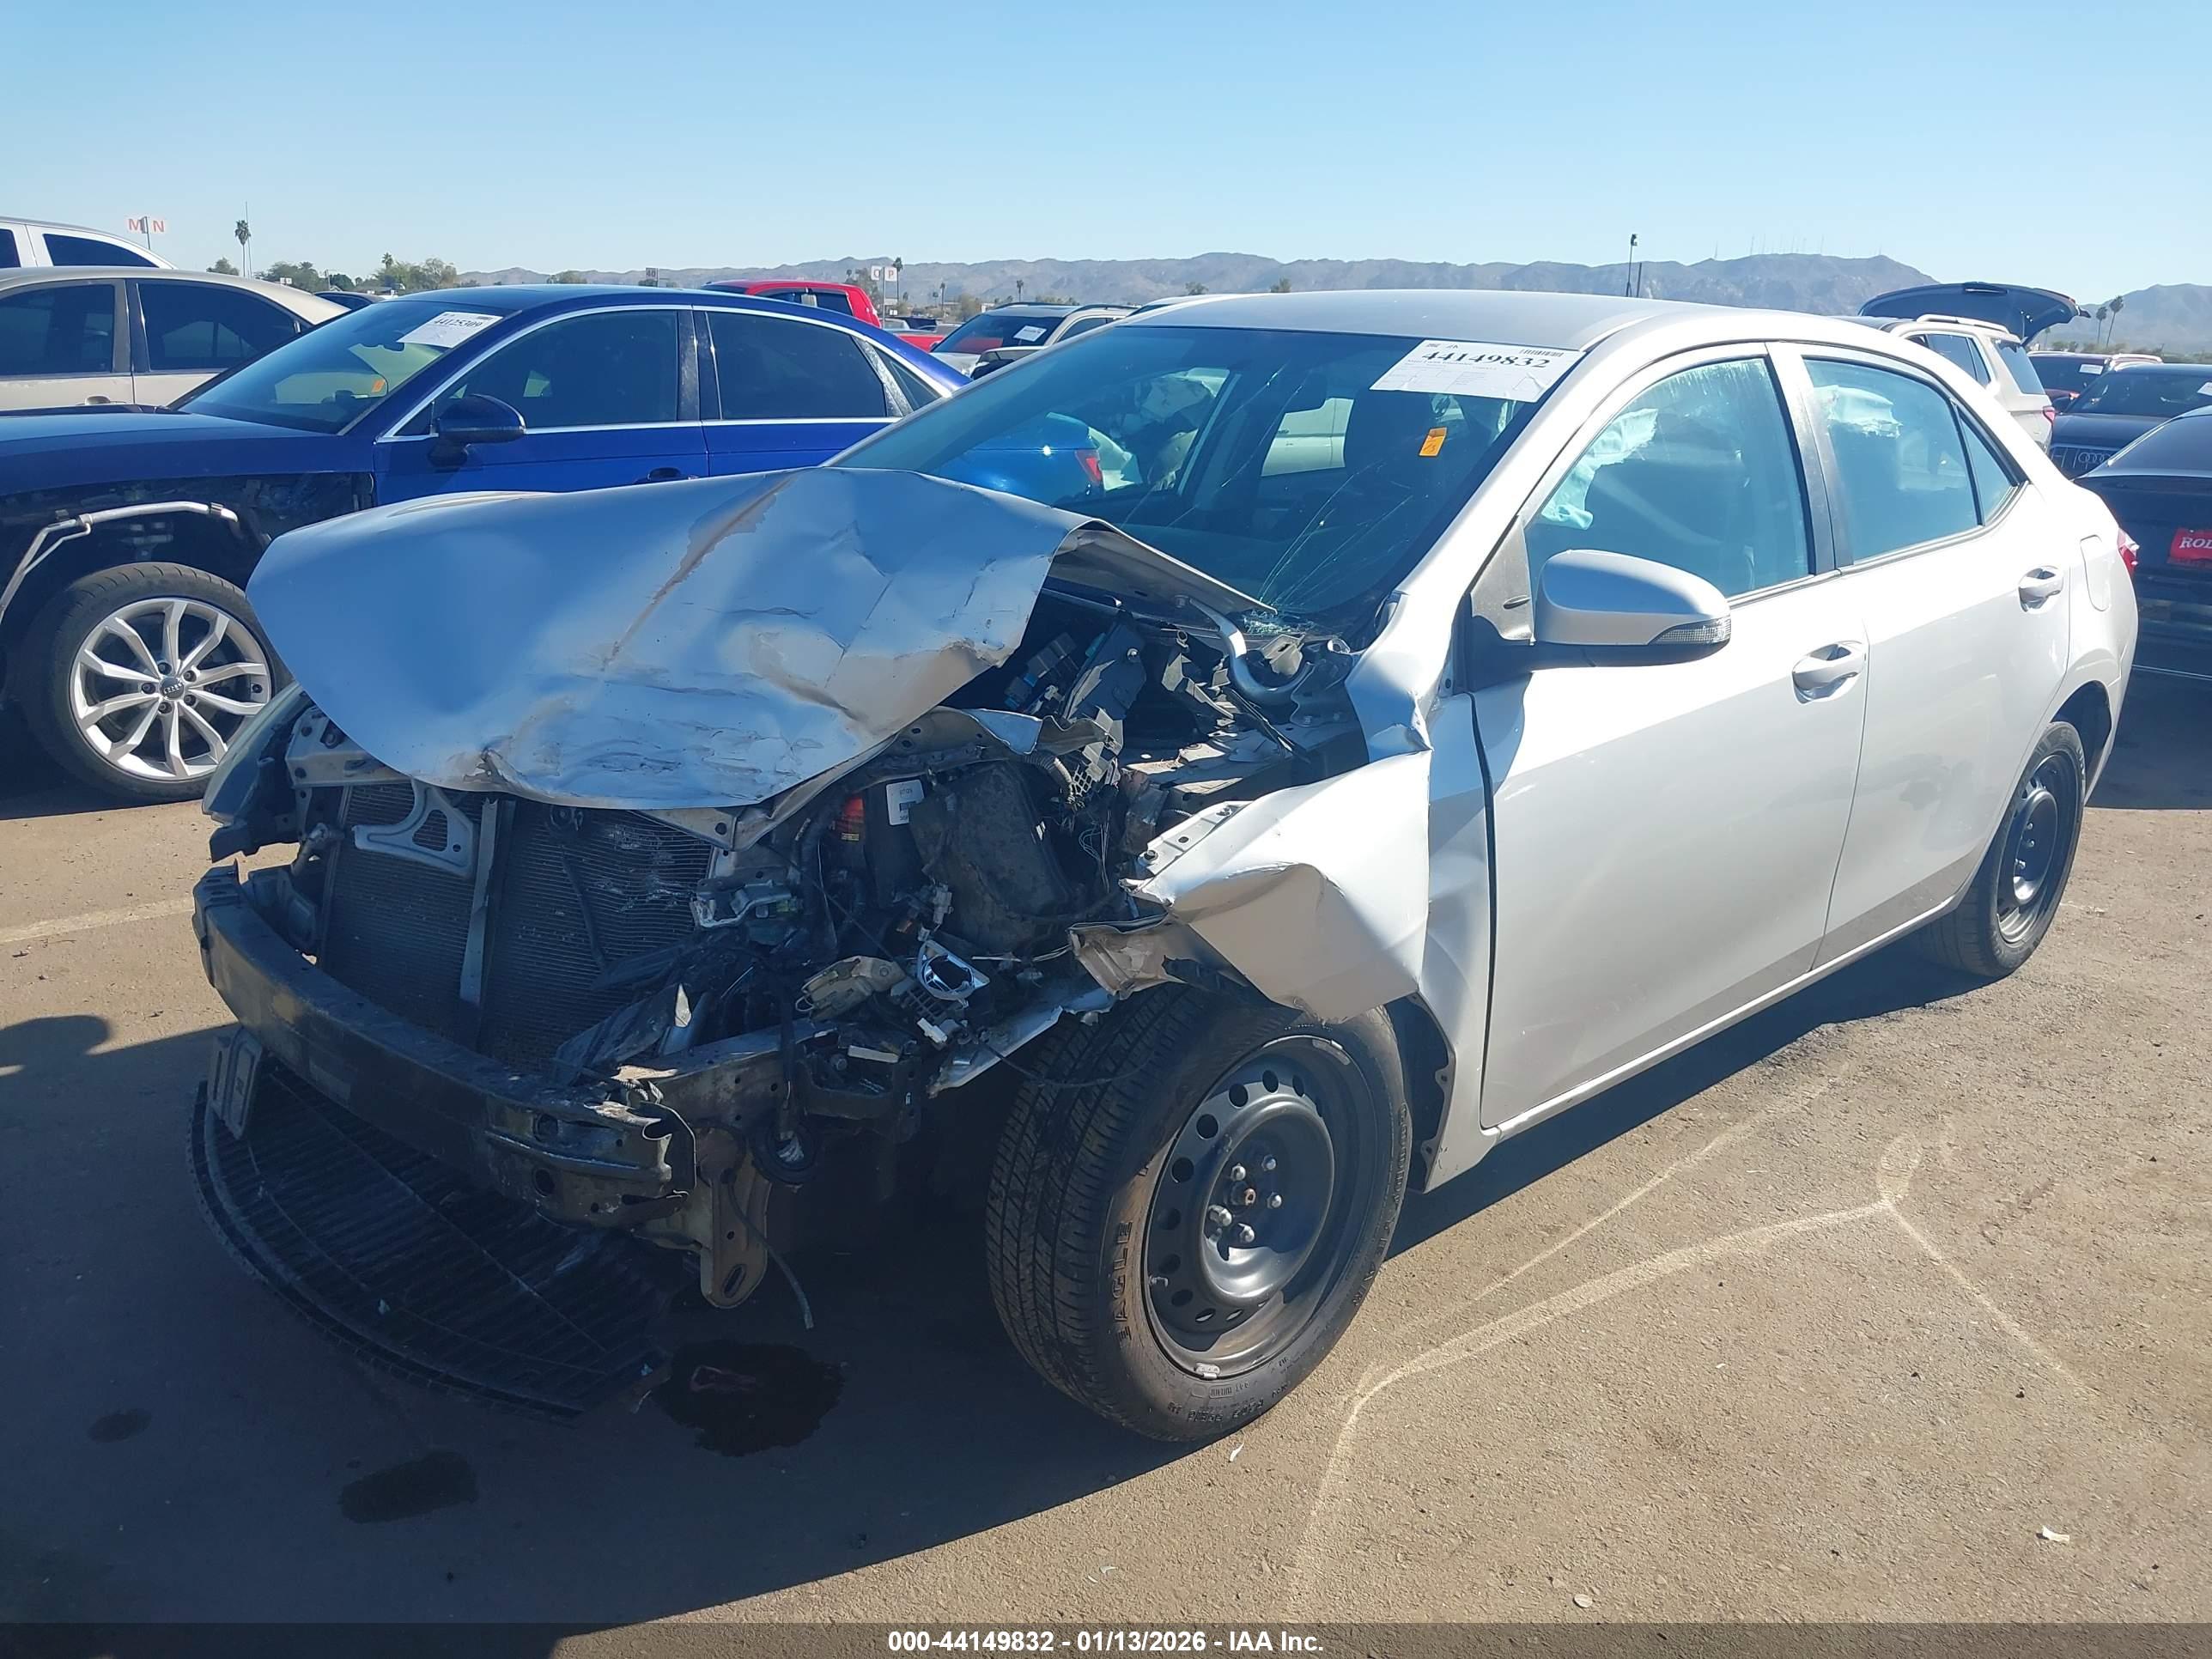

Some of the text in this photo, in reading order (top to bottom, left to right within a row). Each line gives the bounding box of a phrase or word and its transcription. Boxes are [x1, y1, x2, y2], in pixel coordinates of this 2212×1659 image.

[128, 218, 164, 233] M N
[888, 270, 894, 279] P
[1422, 350, 1551, 368] 44149832
[1113, 1222, 1133, 1340] EAGLE
